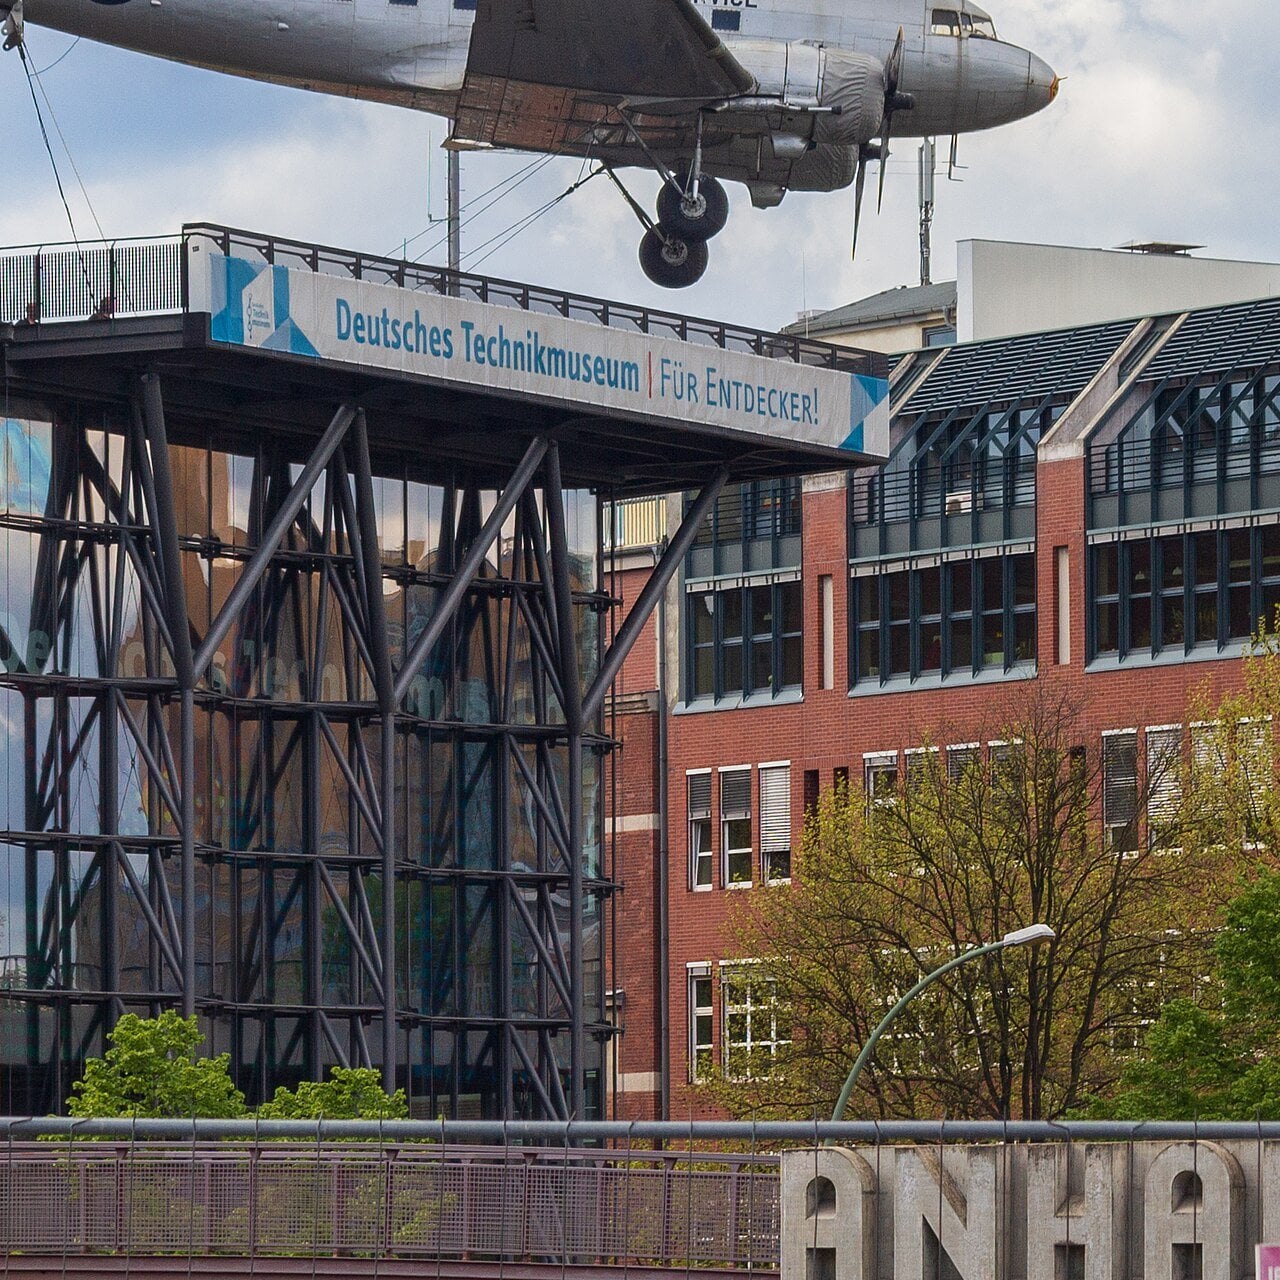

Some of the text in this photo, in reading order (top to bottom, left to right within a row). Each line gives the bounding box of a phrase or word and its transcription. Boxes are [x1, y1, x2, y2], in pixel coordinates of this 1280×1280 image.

[335, 297, 819, 426] Deutsches Technikmuseum FÜR ENTDECKER!
